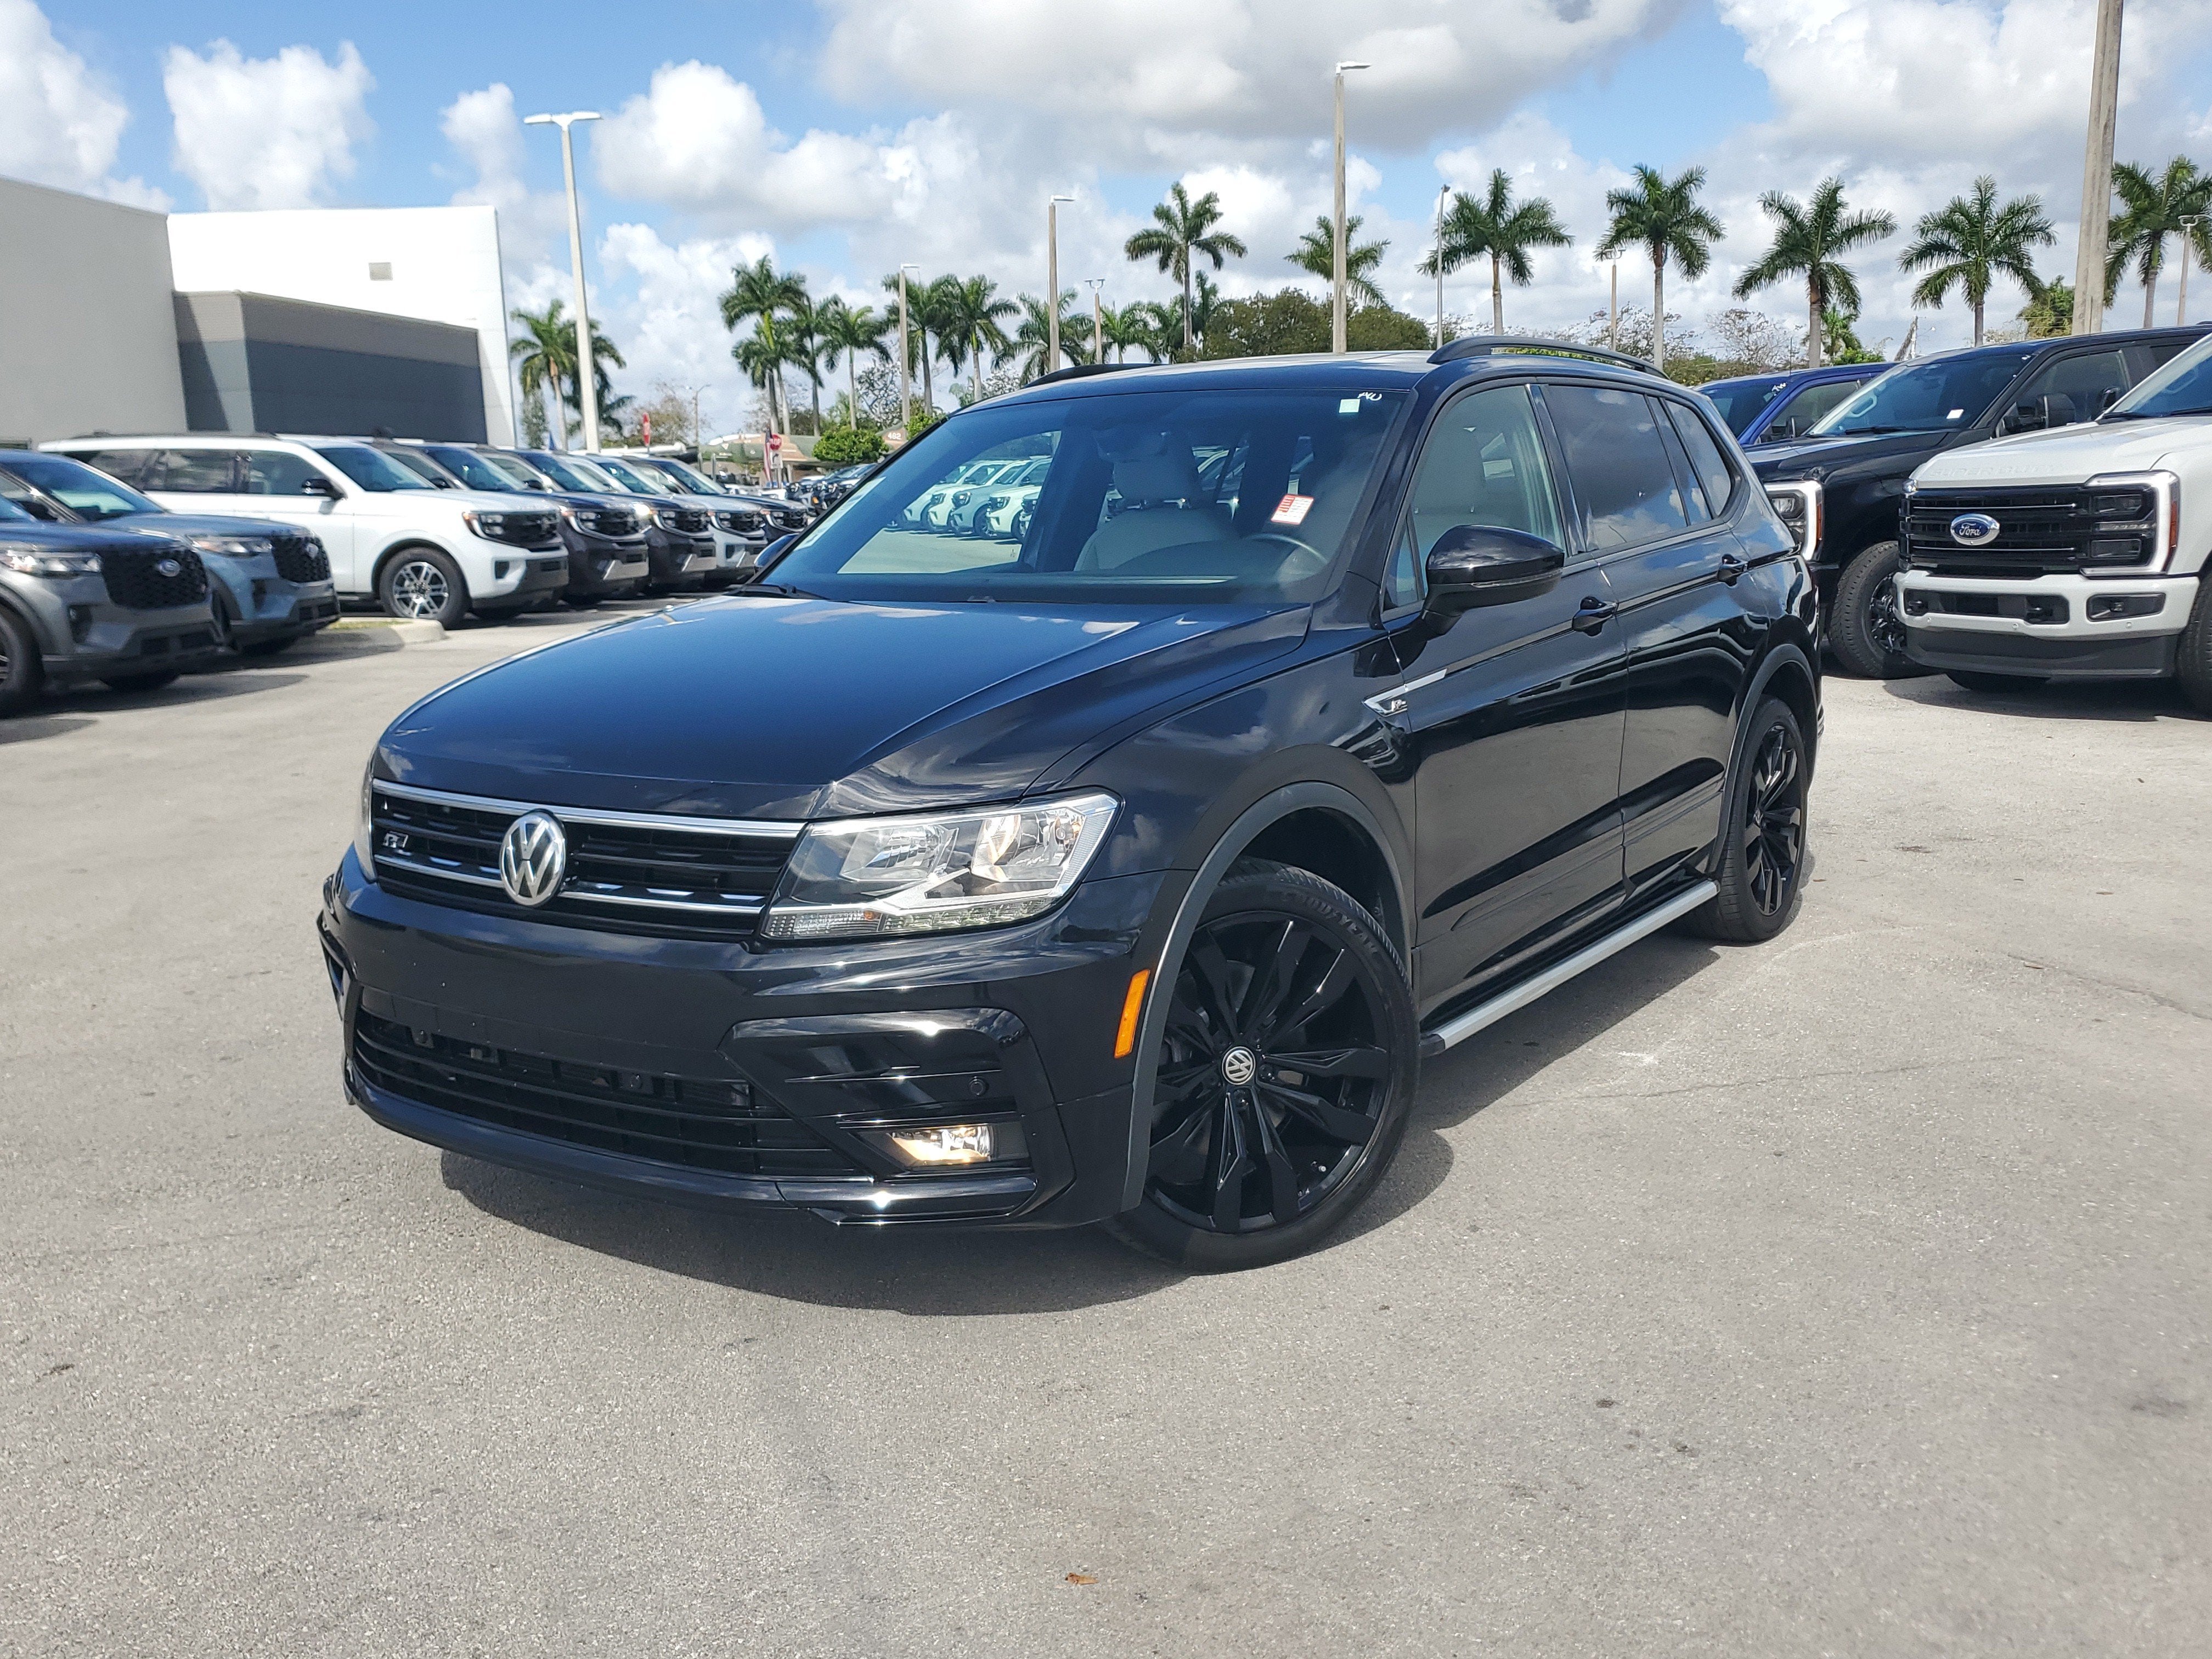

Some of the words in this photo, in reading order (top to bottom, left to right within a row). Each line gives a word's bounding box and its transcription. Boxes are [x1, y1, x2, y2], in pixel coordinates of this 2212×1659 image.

[1959, 522, 1982, 536] Ford
[501, 814, 564, 905] VW
[1224, 1048, 1254, 1083] VW
